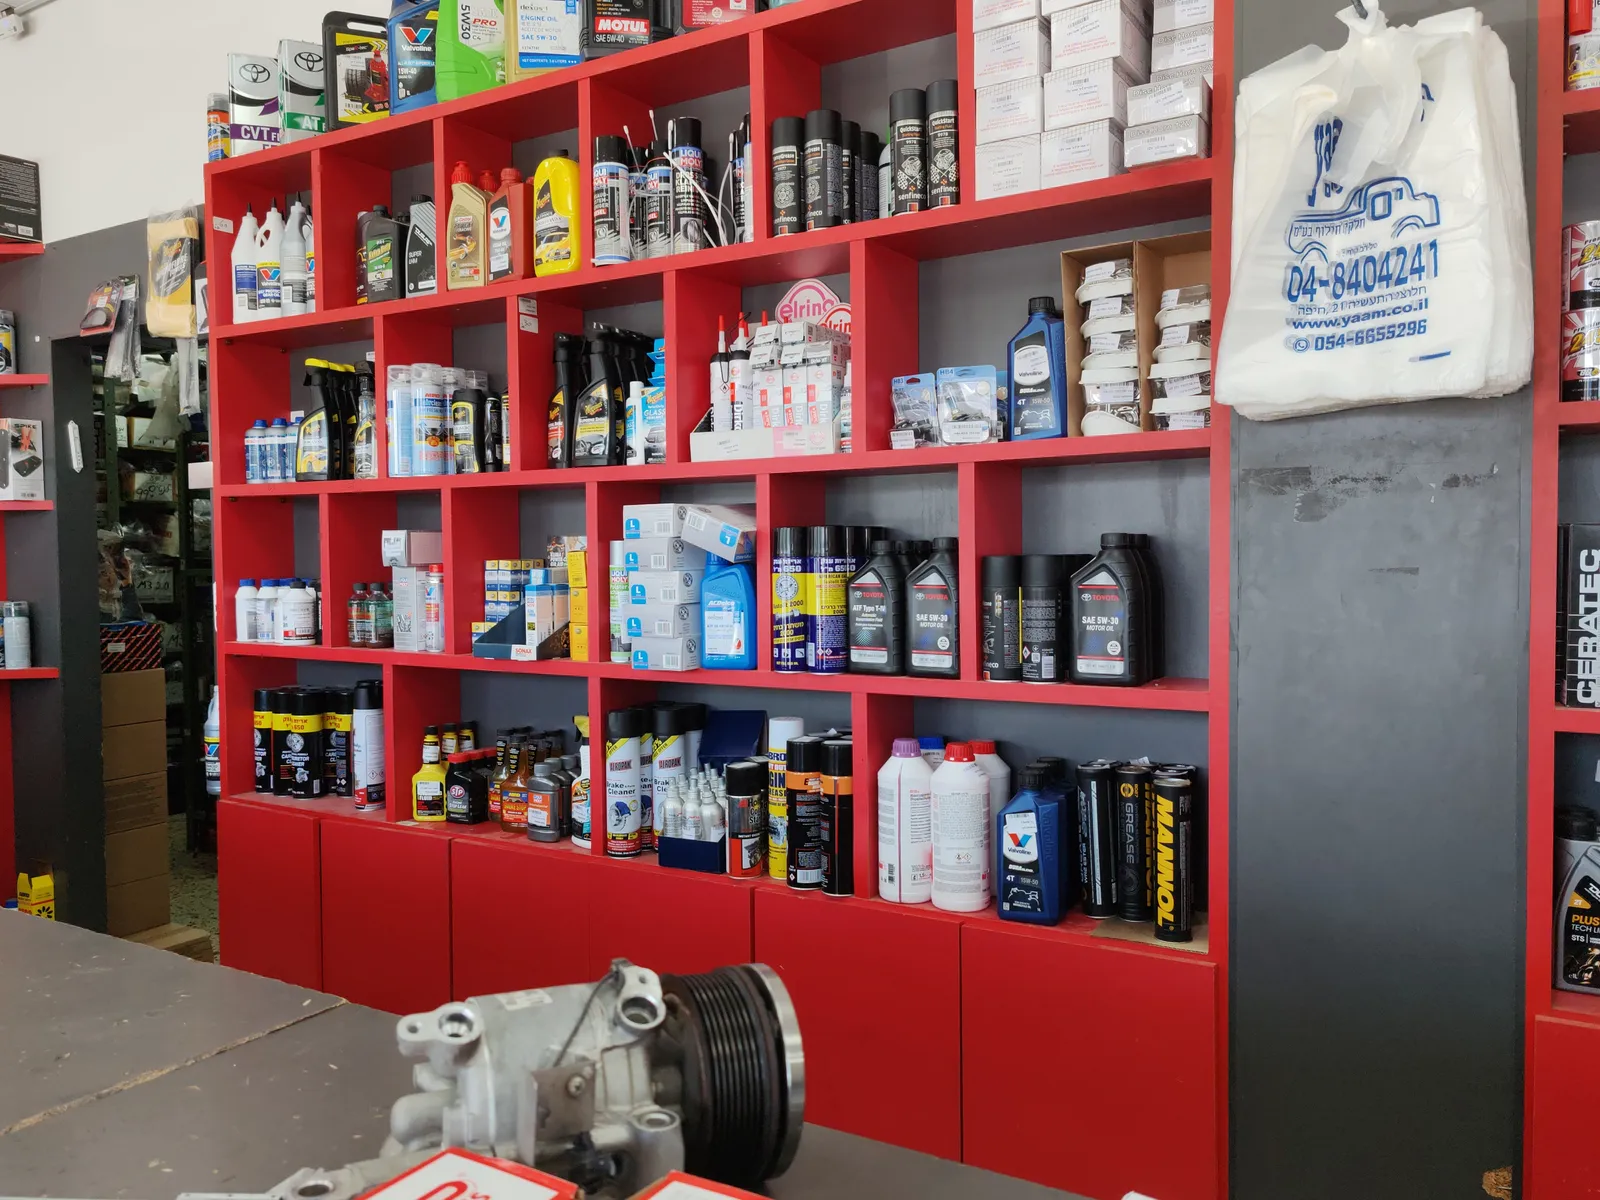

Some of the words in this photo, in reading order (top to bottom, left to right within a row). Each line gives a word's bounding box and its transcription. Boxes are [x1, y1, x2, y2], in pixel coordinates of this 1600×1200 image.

[461, 4, 471, 40] 5W30
[472, 18, 497, 26] PRO
[598, 19, 647, 32] MOTUL
[302, 116, 320, 130] AT
[240, 125, 270, 141] CVT
[931, 186, 959, 195] senfineco
[1316, 223, 1342, 238] חילוף
[1343, 218, 1366, 235] חלקי
[1287, 239, 1438, 303] 04-8404241
[1292, 298, 1428, 329] www.yaam.co.il
[1297, 305, 1326, 316] חיפה
[1315, 319, 1427, 351] 054-6655296
[1092, 594, 1119, 602] TOYOTA
[929, 614, 948, 622] 5W-30
[1082, 616, 1097, 624] SAE
[1097, 617, 1119, 625] 5W-30
[610, 761, 632, 771] AEROPAK
[659, 757, 681, 769] AEROPAK
[451, 787, 463, 797] STP
[1126, 803, 1134, 864] GREASE
[1008, 847, 1031, 855] Valvoline
[1156, 794, 1174, 927] MANNOL
[1572, 915, 1600, 926] PLUS
[1572, 924, 1592, 932] TECH
